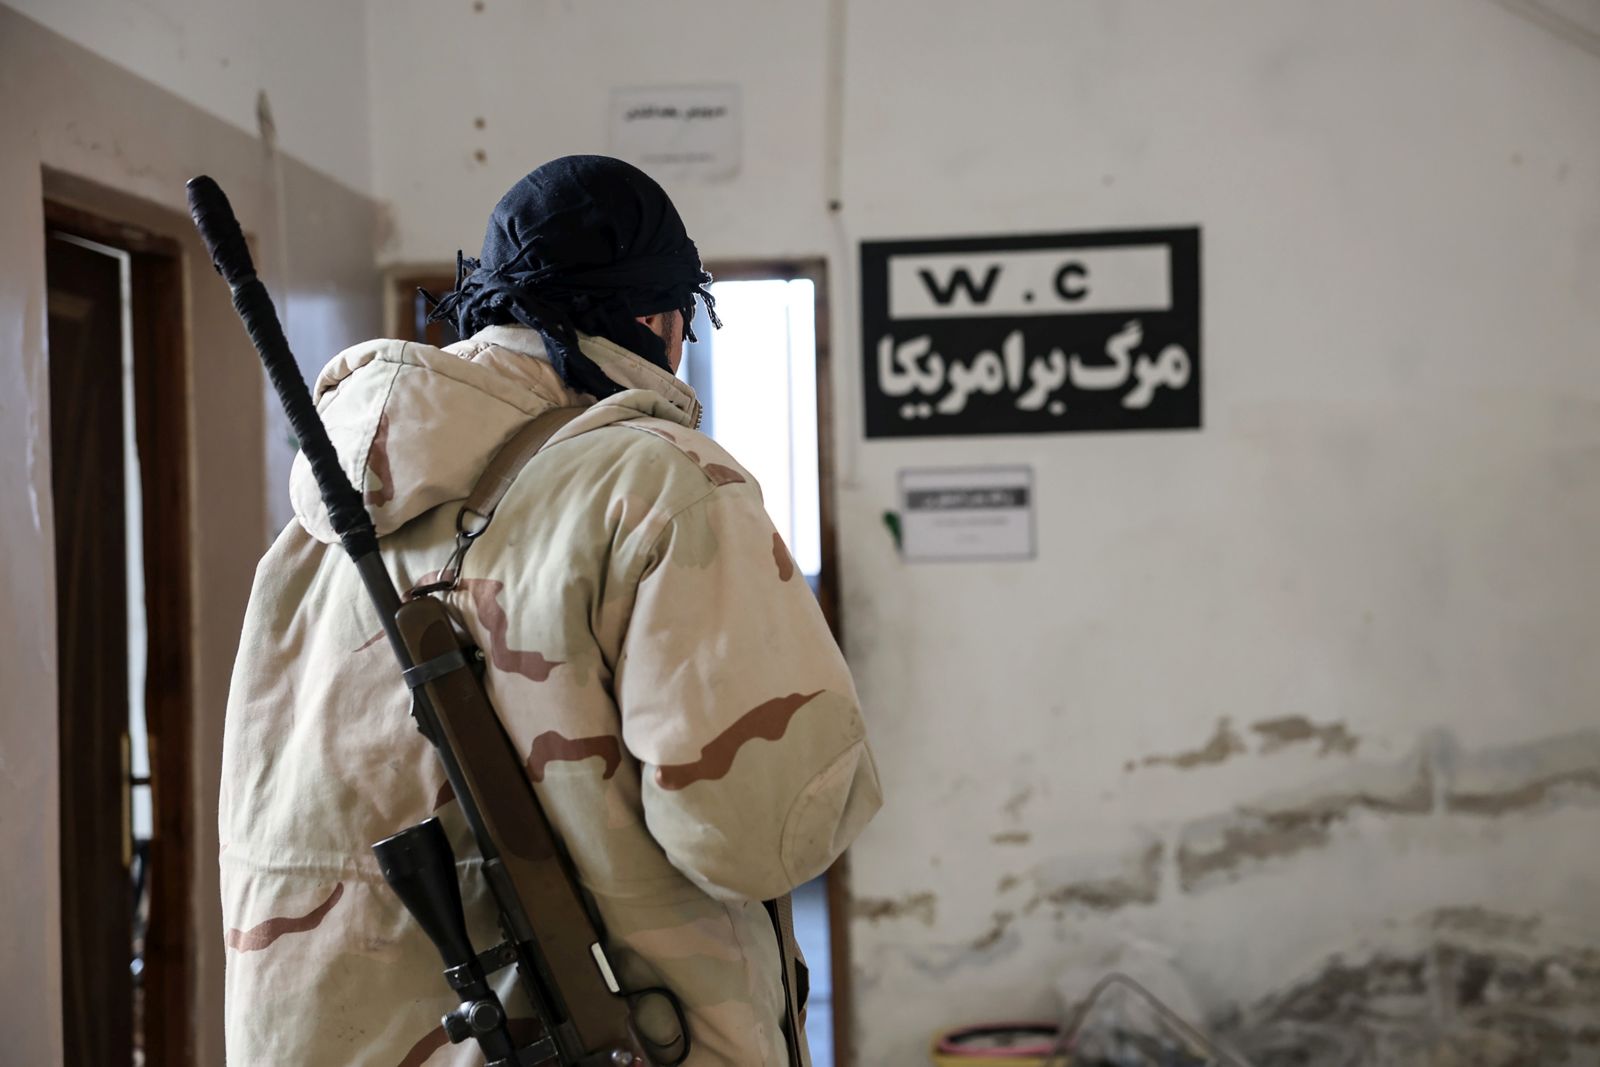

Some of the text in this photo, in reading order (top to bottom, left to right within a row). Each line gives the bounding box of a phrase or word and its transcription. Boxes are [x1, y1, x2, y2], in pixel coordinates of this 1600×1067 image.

[877, 320, 1190, 419] مرگ بر امریکا
